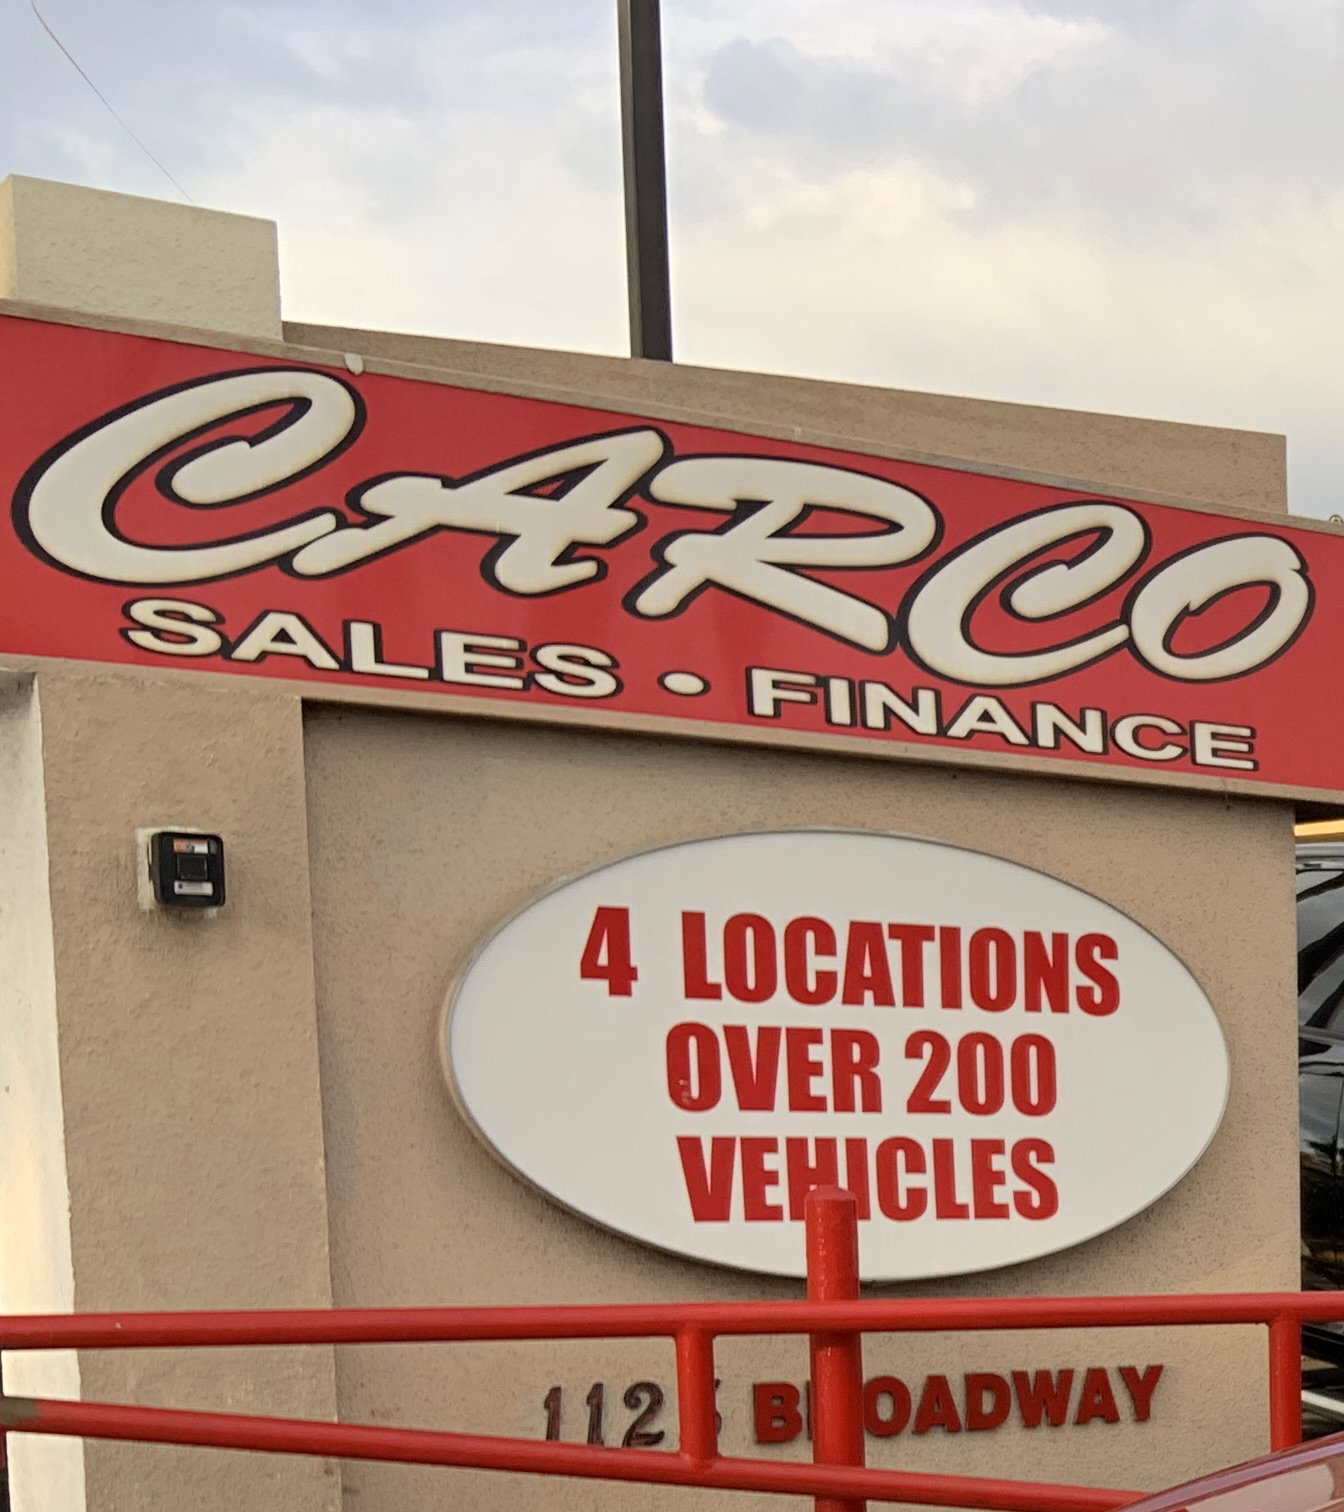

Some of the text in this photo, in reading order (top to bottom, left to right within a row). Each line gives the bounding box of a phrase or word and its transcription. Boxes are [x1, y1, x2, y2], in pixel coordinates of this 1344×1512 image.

[13, 367, 1313, 684] CARCO
[121, 597, 1257, 770] SALES FINANCE
[580, 906, 1121, 1017] 4 LOCATIONS
[665, 1022, 1058, 1117] OVER 200
[676, 1135, 1060, 1223] VEHICLES
[544, 1364, 1165, 1448] 112 BOADWAY
